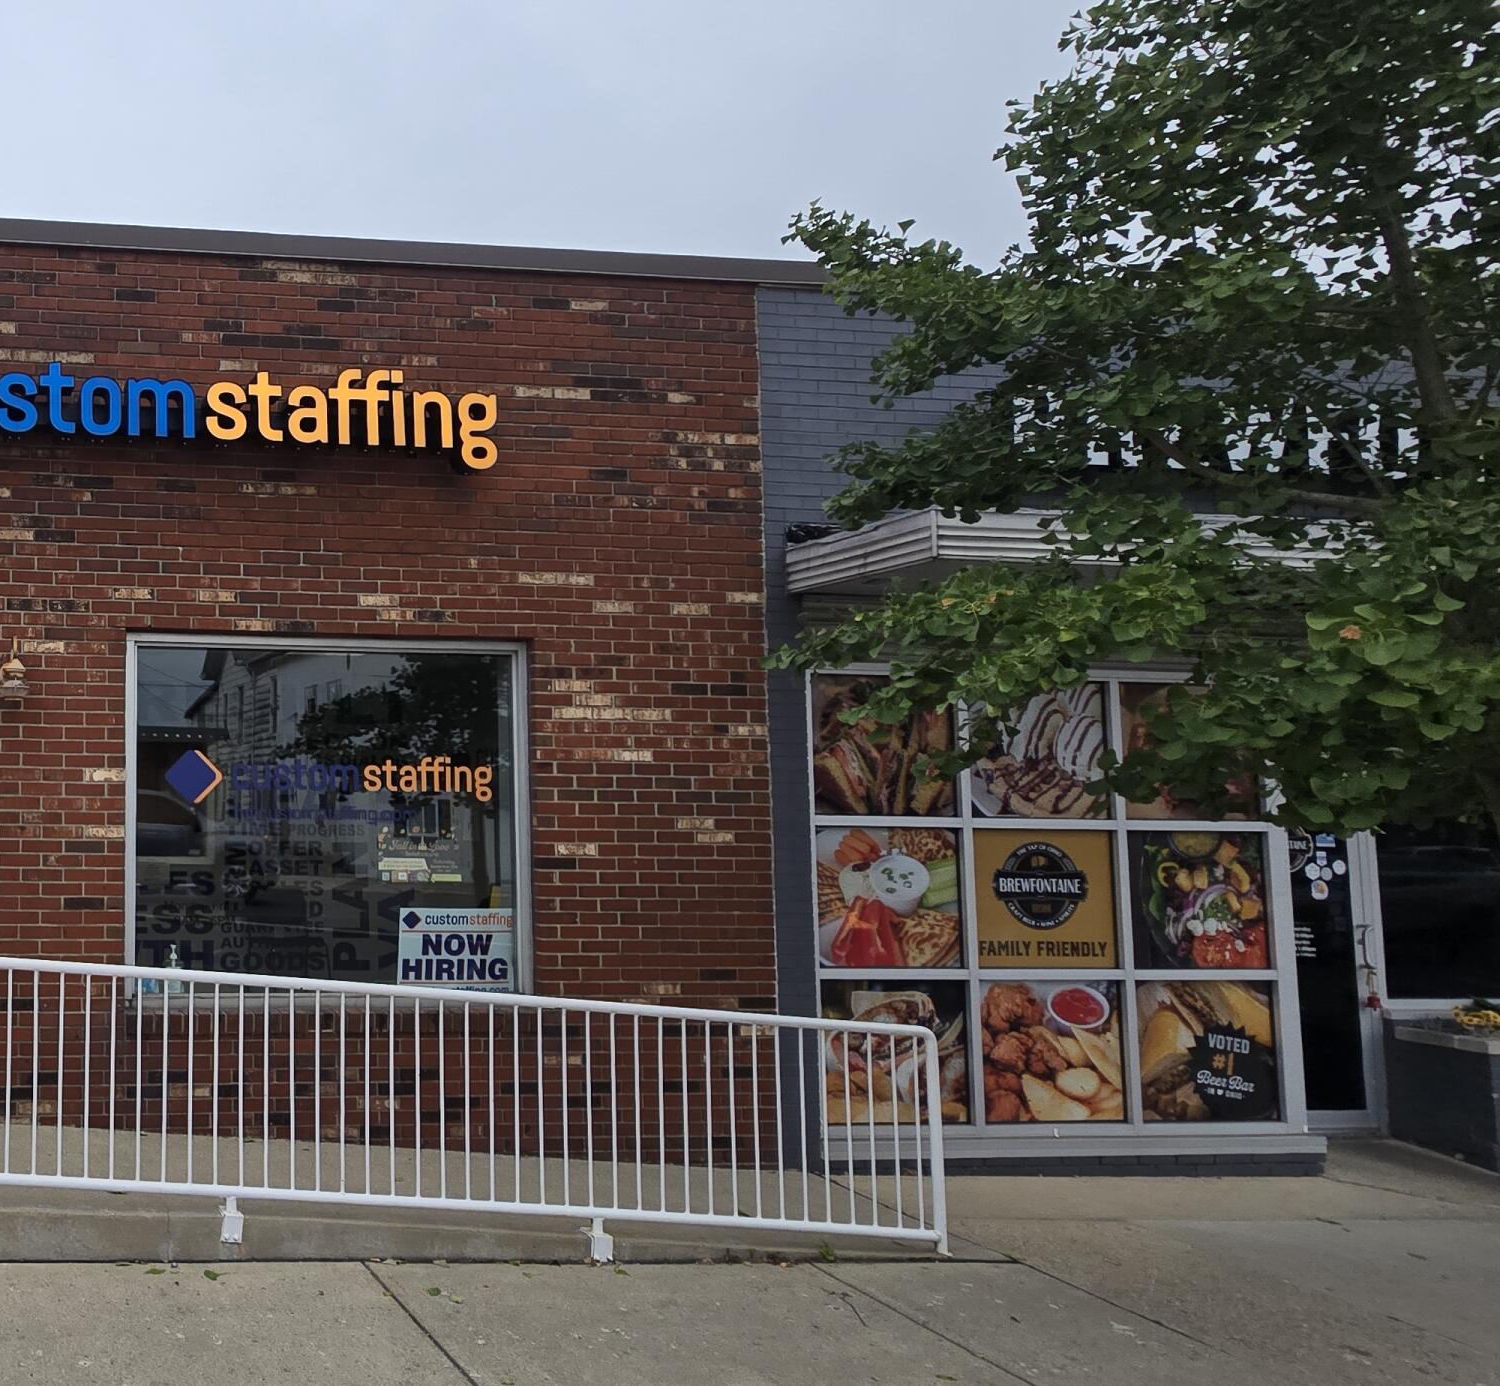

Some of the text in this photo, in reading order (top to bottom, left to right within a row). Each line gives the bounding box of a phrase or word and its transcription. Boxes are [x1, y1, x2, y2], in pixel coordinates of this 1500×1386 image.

[206, 368, 498, 471] staffing
[363, 756, 493, 802] staffing
[290, 823, 365, 837] PROGRESS
[247, 840, 323, 857] OFFER
[249, 859, 324, 876] ASSET
[998, 877, 1083, 894] BREWFONTAINE
[421, 933, 494, 956] NOW
[979, 940, 1108, 958] FAMILY FRIENDLY
[219, 951, 326, 972] GOODS
[401, 957, 509, 981] HIRING
[1207, 1032, 1251, 1055] VOTED
[1212, 1052, 1235, 1076] #1
[1196, 1069, 1256, 1093] Beer Bar
